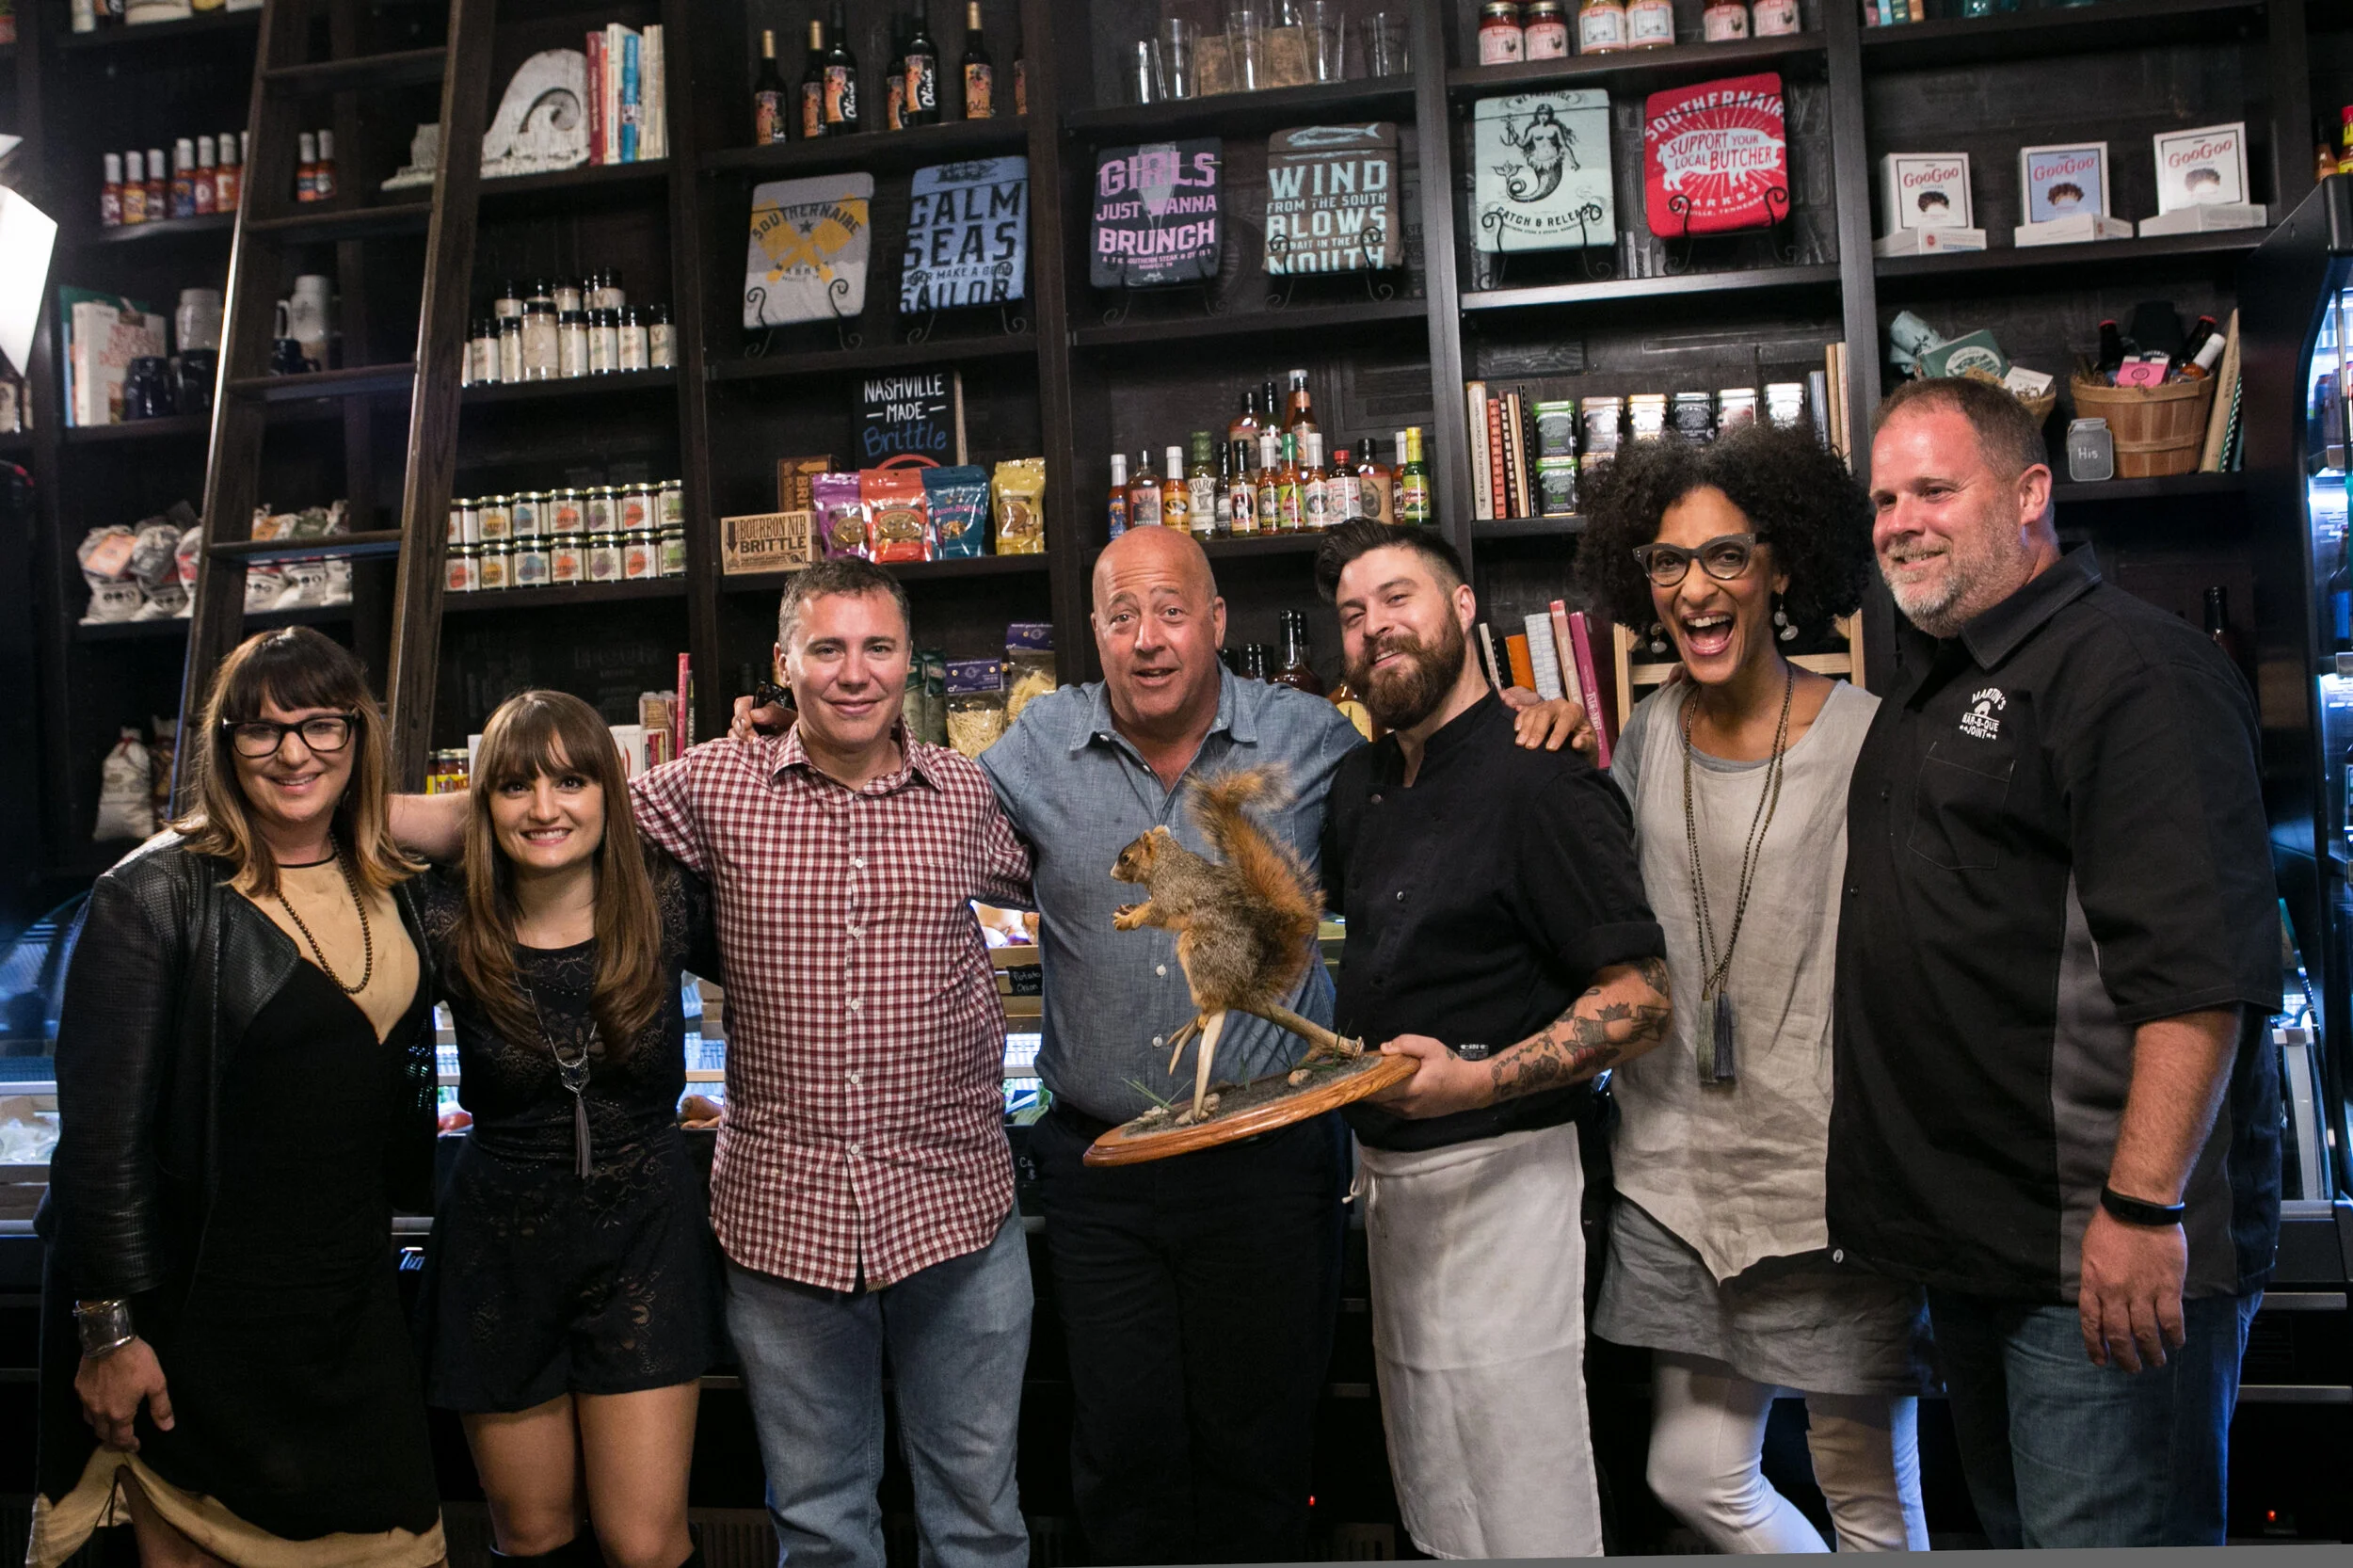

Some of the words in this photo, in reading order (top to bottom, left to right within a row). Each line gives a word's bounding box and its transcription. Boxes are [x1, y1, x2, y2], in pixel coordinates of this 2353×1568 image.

[1669, 133, 1728, 159] SUPPORT
[1732, 134, 1759, 146] YOUR
[2169, 139, 2233, 168] GooGoo
[1675, 154, 1708, 170] LOCAL
[1710, 146, 1772, 171] BUTCHER
[2034, 158, 2095, 182] GooGoo
[1099, 151, 1217, 198] GIRLS
[1268, 159, 1388, 200] WIND
[1904, 168, 1959, 187] GooGoo
[1096, 200, 1142, 222] JUST
[1267, 199, 1306, 215] FROM
[1311, 197, 1337, 210] THE
[1341, 192, 1388, 207] SOUTH
[753, 203, 862, 241] SOUTHERNAIRE
[1267, 205, 1387, 242] BLOWS
[1097, 217, 1216, 256] BRUNCH
[1332, 235, 1352, 248] THE
[936, 267, 968, 280] MAKE
[971, 265, 979, 277] A
[864, 374, 945, 404] NASHVILLE
[886, 401, 926, 424] MADE
[862, 421, 947, 458] Brittle
[2077, 446, 2099, 459] His
[740, 517, 786, 539] BOURBON
[788, 515, 807, 536] NIB
[741, 536, 807, 553] BRITTLE
[1972, 688, 2007, 711] MARTIN'S
[1961, 713, 2000, 732] BAR-B-QUE
[1967, 726, 1988, 739] JOINT
